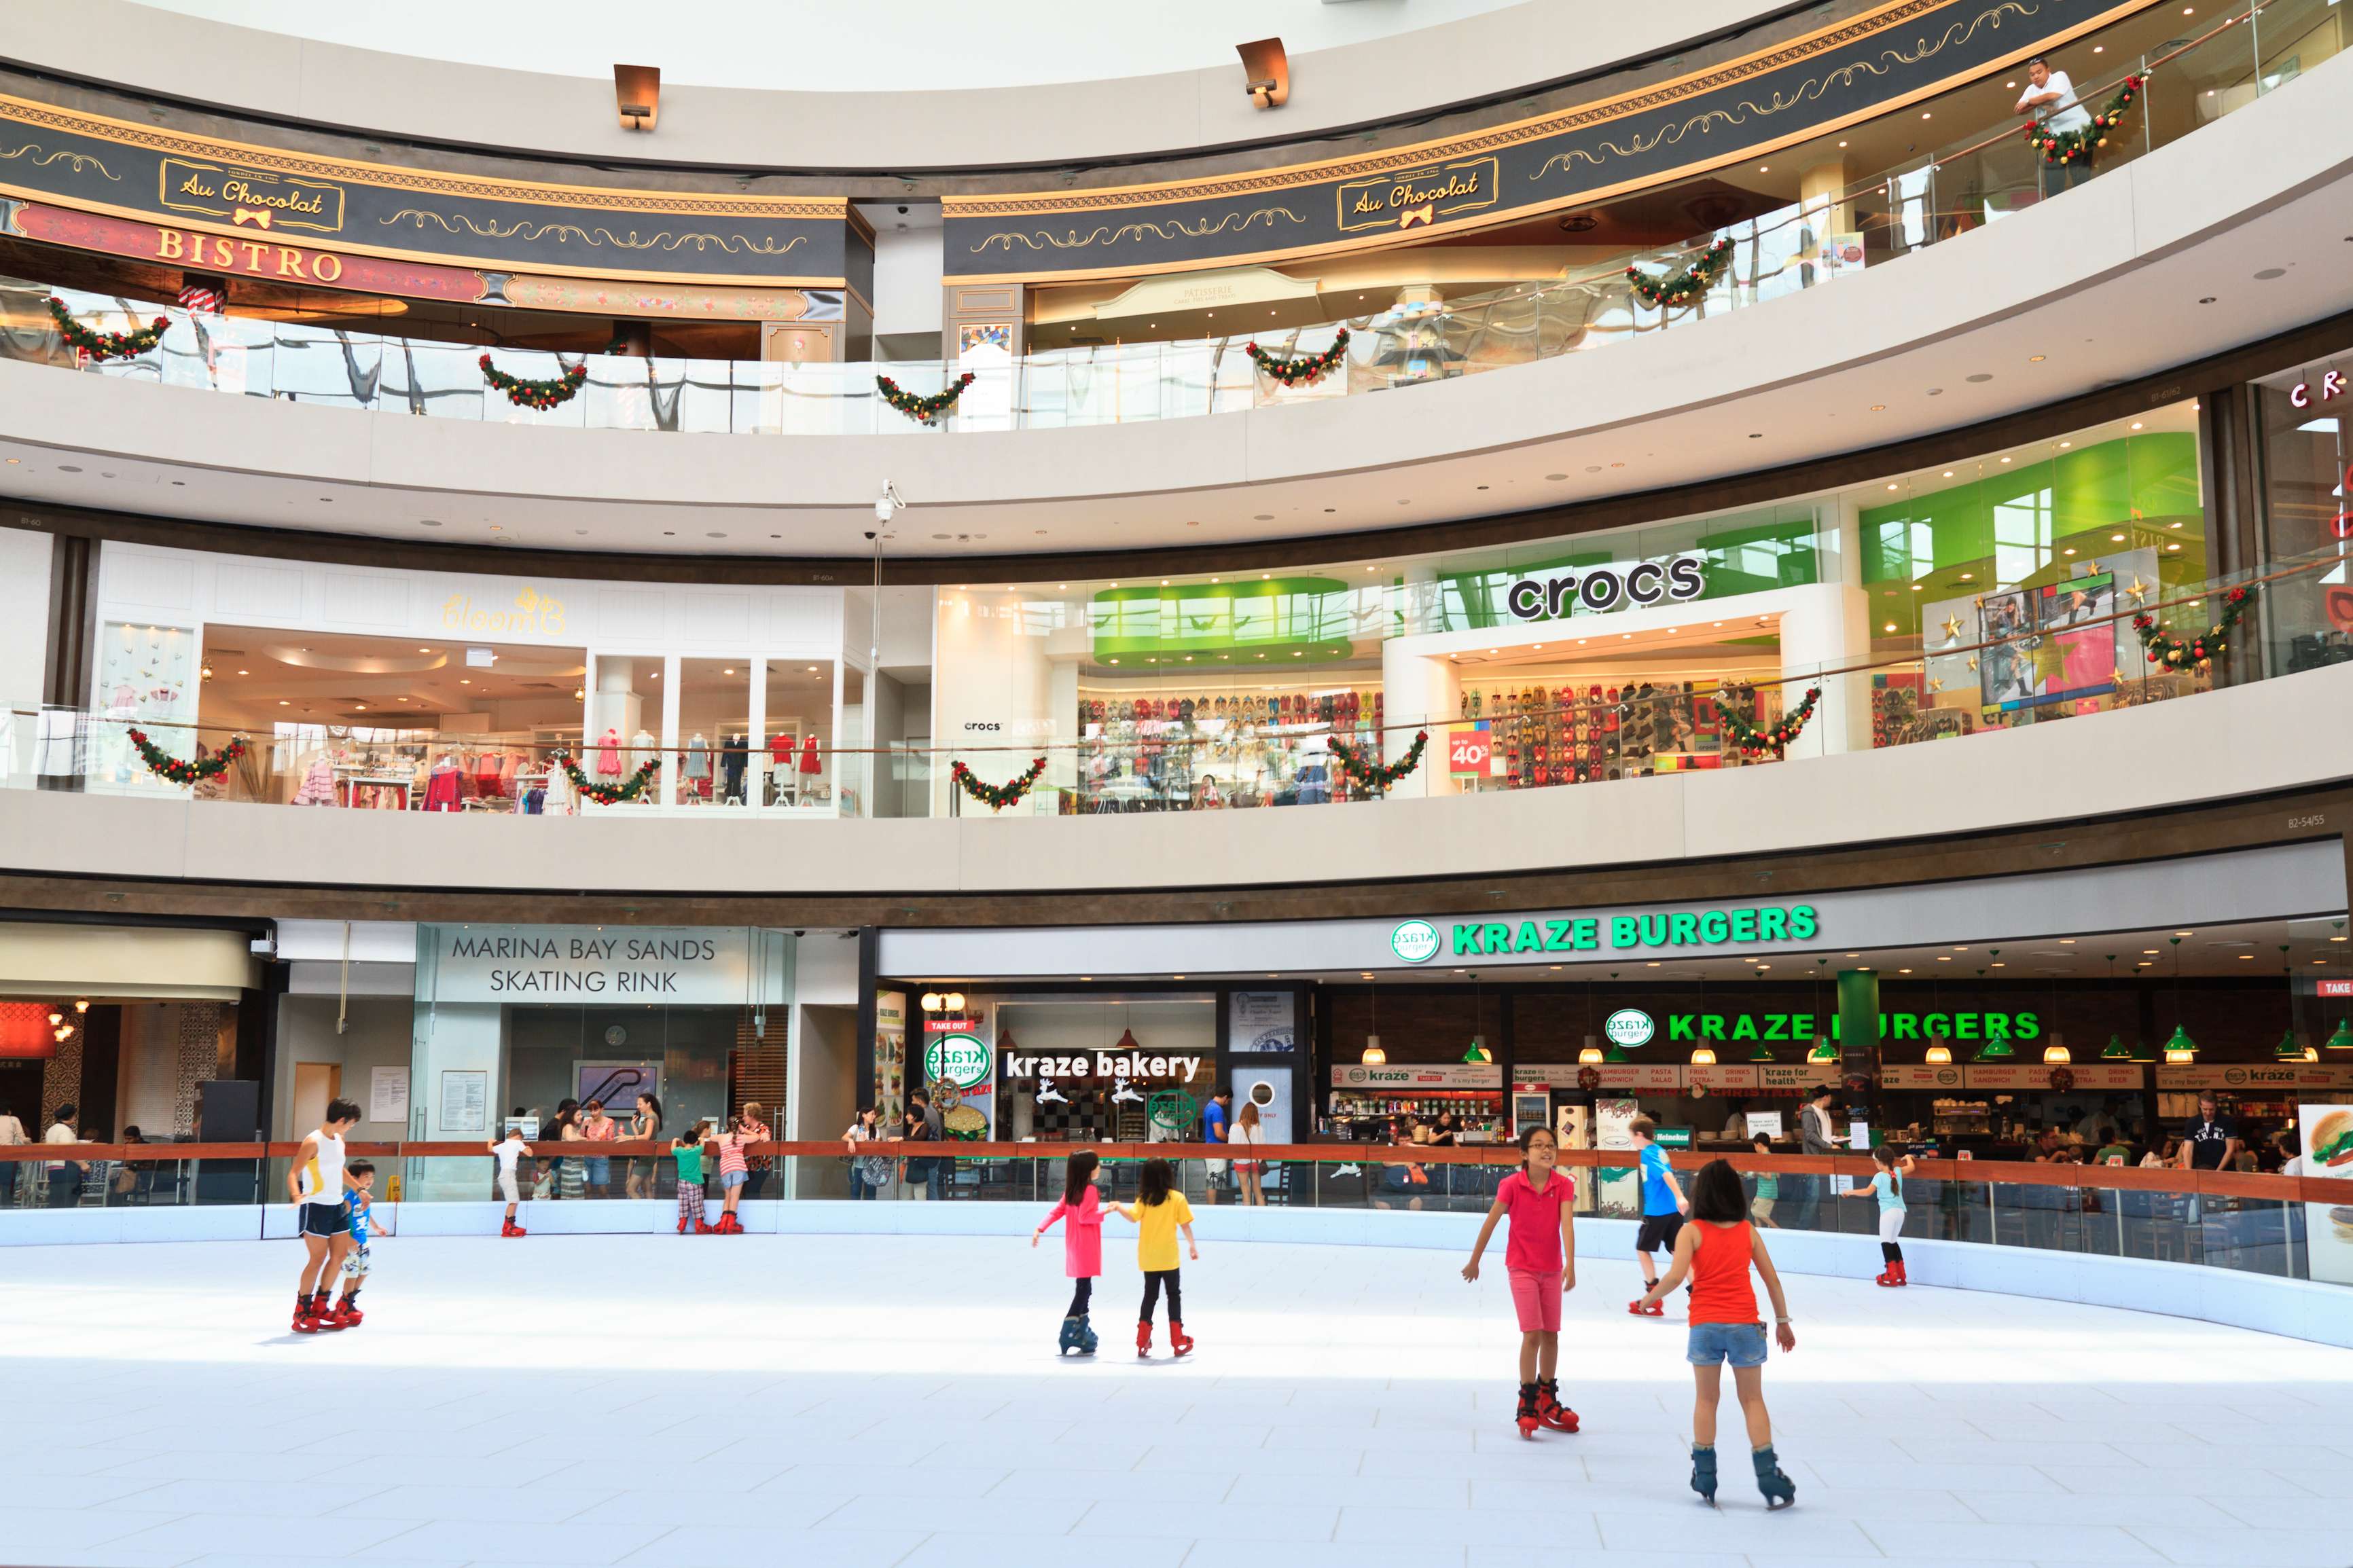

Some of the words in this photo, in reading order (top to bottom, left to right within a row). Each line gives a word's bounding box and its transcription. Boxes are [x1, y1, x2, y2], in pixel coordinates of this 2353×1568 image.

[180, 173, 215, 198] Au
[222, 181, 323, 215] Chocolat
[1353, 191, 1384, 214] Au
[1390, 172, 1479, 207] Chocolat
[156, 228, 342, 282] BISTRO
[2151, 386, 2181, 403] B1-61/62
[21, 517, 41, 526] B1-60
[1507, 558, 1704, 620] crocs
[965, 722, 1001, 731] crocs
[2288, 814, 2324, 828] B2-54/55
[1453, 919, 1598, 954] KRAZE
[1612, 906, 1817, 948] BURGERS
[452, 936, 559, 960] MARINA
[569, 938, 617, 960] BAY
[627, 939, 715, 961] SANDS
[490, 970, 607, 991] SKATING
[617, 972, 678, 992] RINK
[2326, 983, 2351, 993] TAKE
[1669, 1014, 1814, 1040] KRAZE
[1007, 1052, 1089, 1077] kraze
[1096, 1051, 1201, 1082] bakery
[1369, 1070, 1409, 1081] kraze
[2250, 1070, 2295, 1080] kraze
